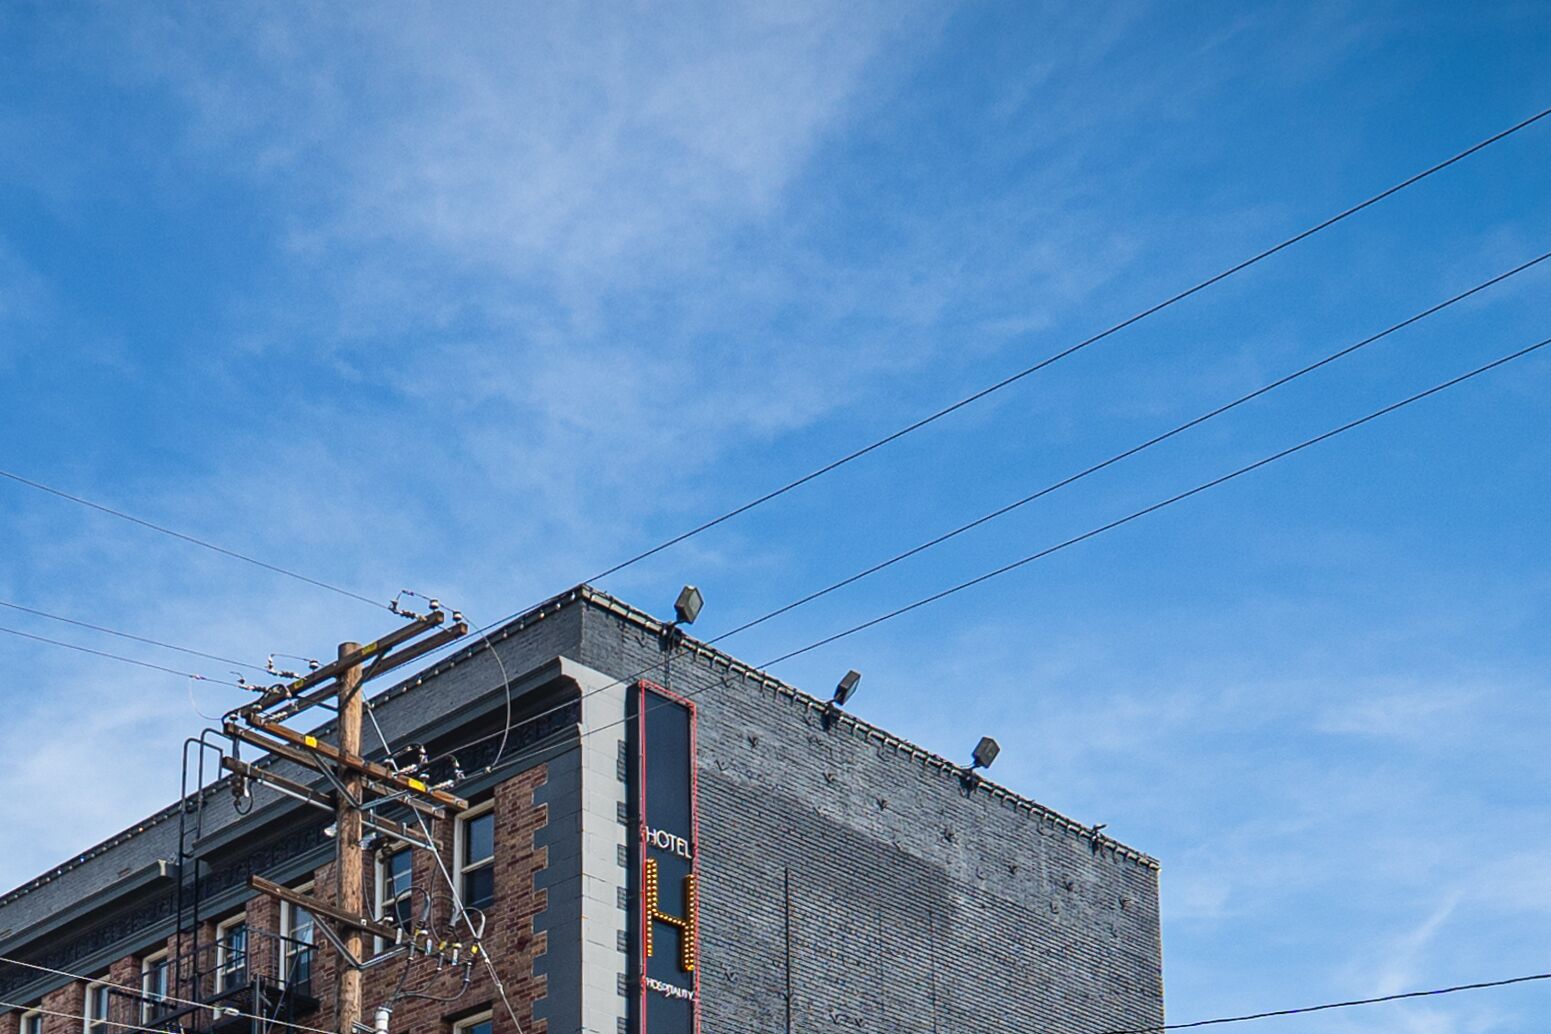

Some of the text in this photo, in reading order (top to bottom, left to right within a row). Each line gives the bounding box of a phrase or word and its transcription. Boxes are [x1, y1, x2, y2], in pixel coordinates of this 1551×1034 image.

[645, 825, 693, 859] HOTEL
[645, 858, 696, 973] H
[645, 976, 694, 1001] HOSPITALITY
